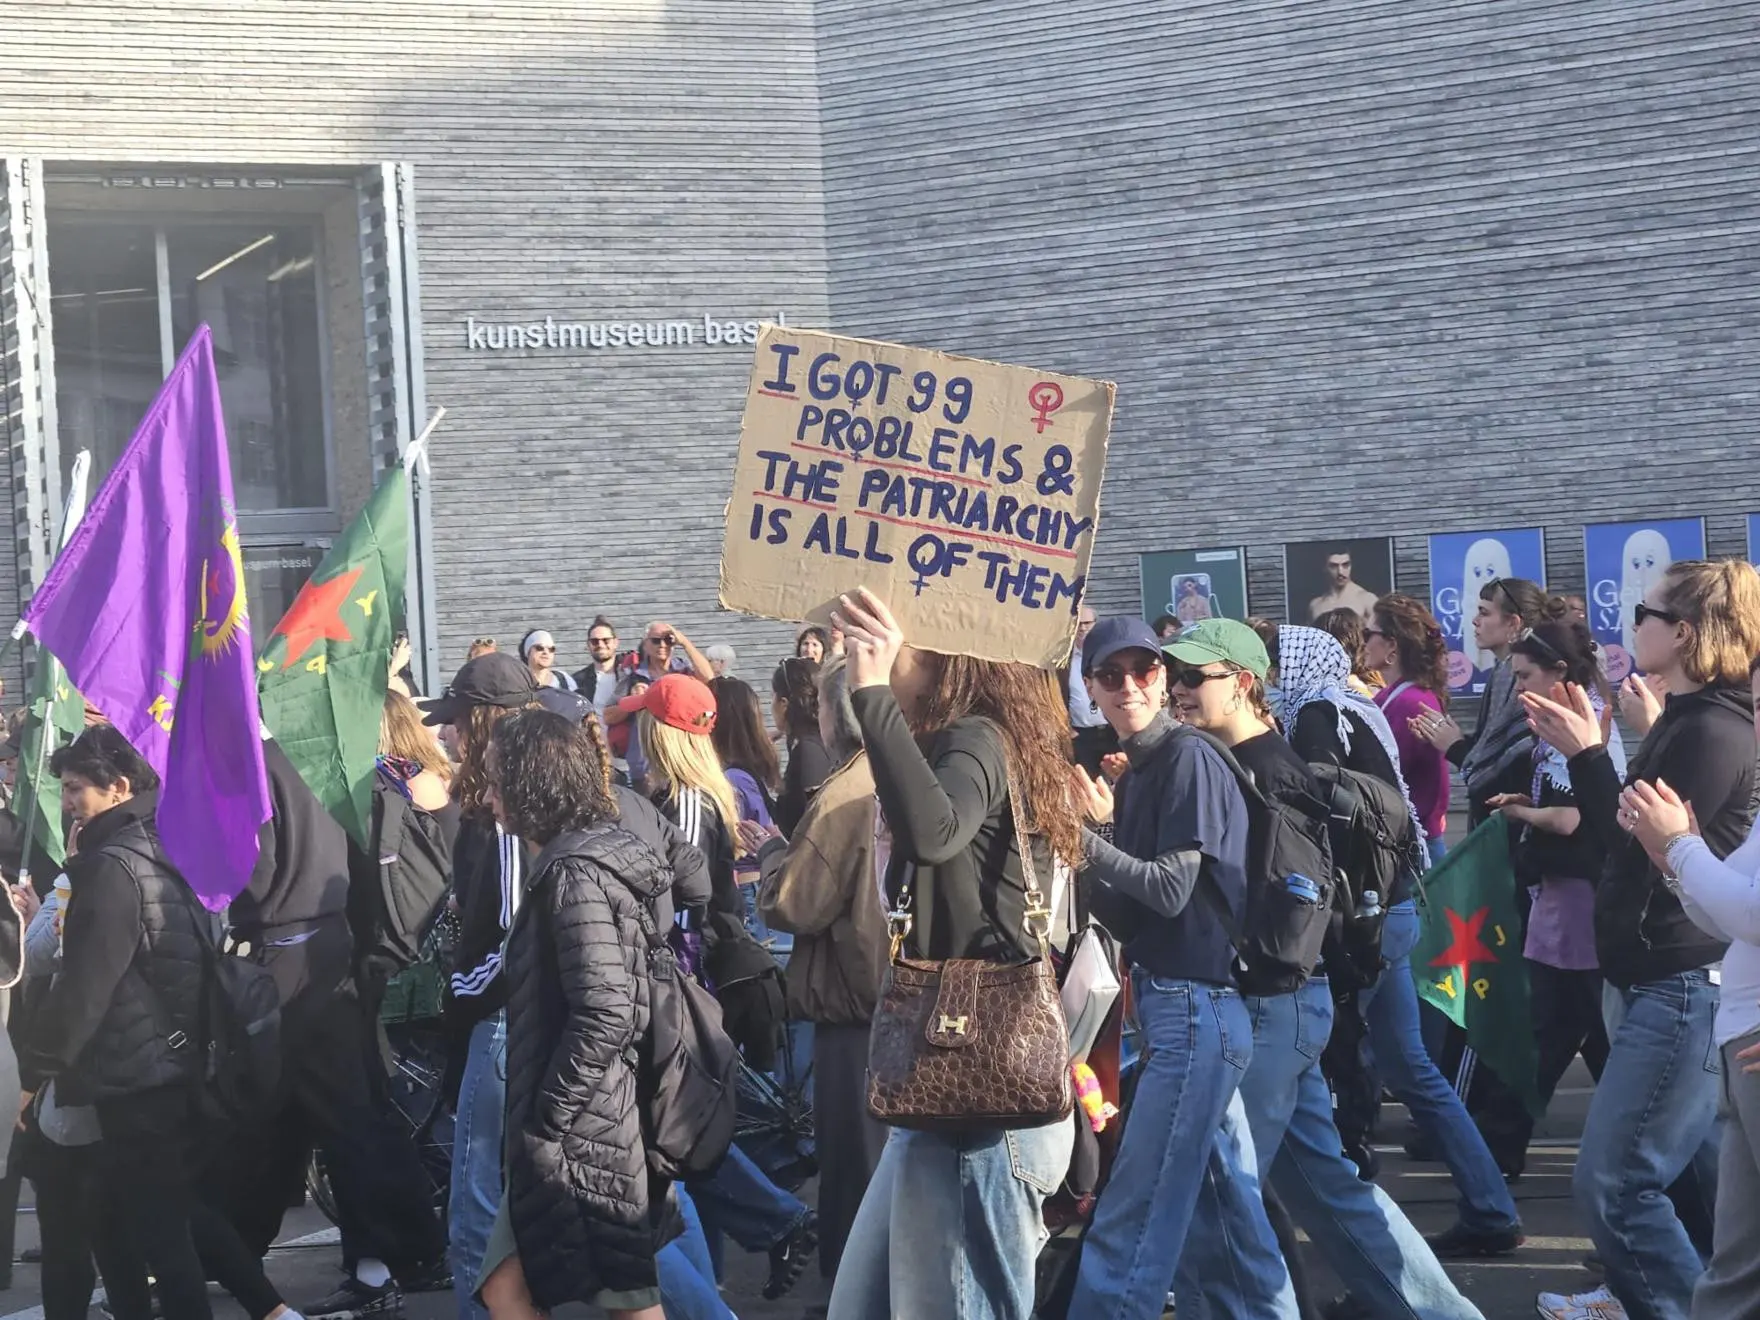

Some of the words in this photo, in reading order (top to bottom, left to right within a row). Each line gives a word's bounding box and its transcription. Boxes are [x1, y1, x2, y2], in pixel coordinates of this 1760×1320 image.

[467, 316, 693, 349] kunstmuseum
[704, 311, 785, 344] basl
[763, 343, 800, 393] I
[807, 352, 902, 409] GOT
[906, 371, 973, 424] 99
[796, 404, 1023, 484] PROBLEMS
[1035, 444, 1074, 496] &
[756, 450, 844, 502] THE
[857, 468, 1095, 550] PATRIARCHY
[750, 503, 792, 545] IS
[802, 513, 894, 563] ALL
[907, 533, 974, 597] OF
[977, 551, 1087, 616] THEM
